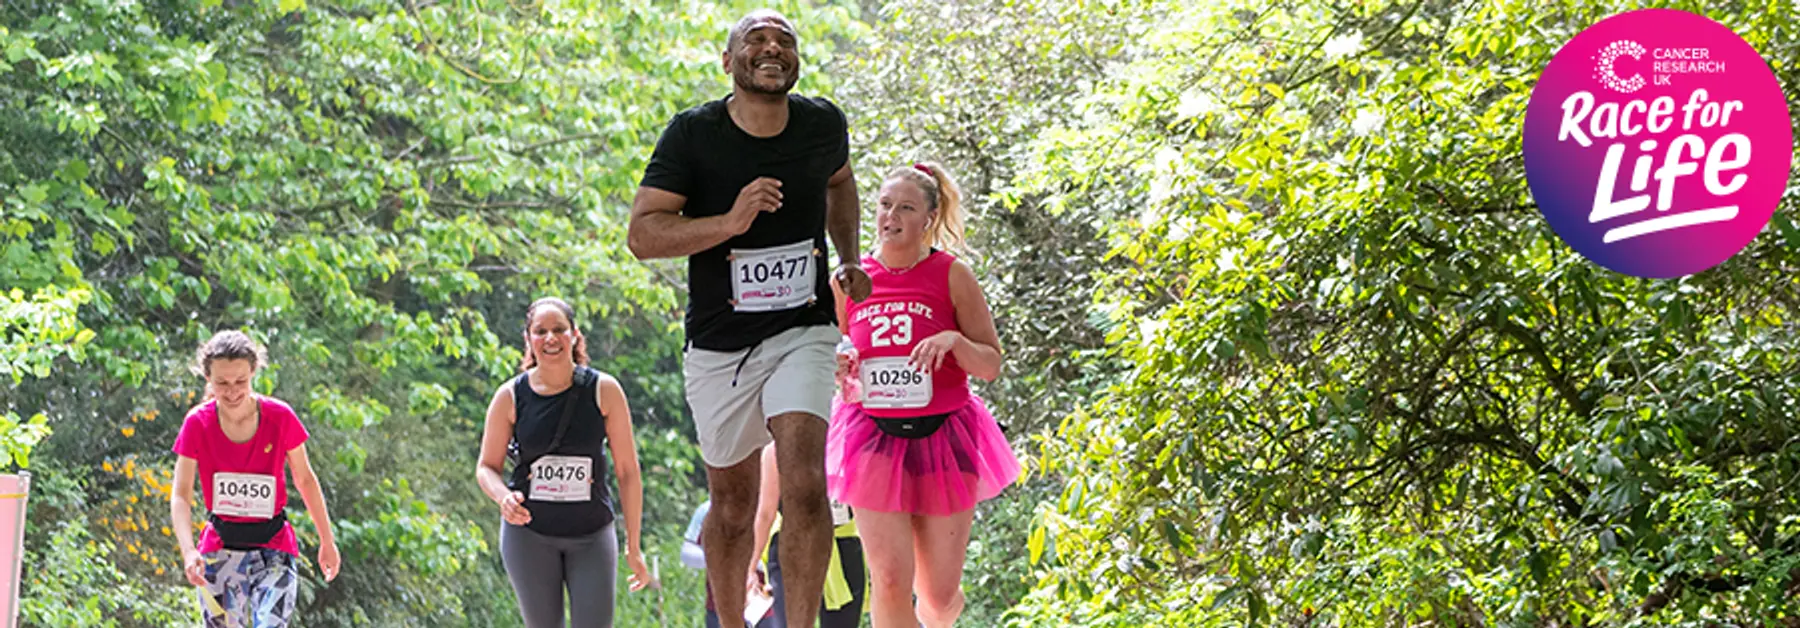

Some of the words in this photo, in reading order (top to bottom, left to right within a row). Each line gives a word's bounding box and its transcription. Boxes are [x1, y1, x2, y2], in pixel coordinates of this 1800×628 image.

[740, 255, 808, 283] 10477
[869, 370, 923, 385] 10296
[536, 465, 585, 481] 10476
[219, 482, 271, 499] 10450
